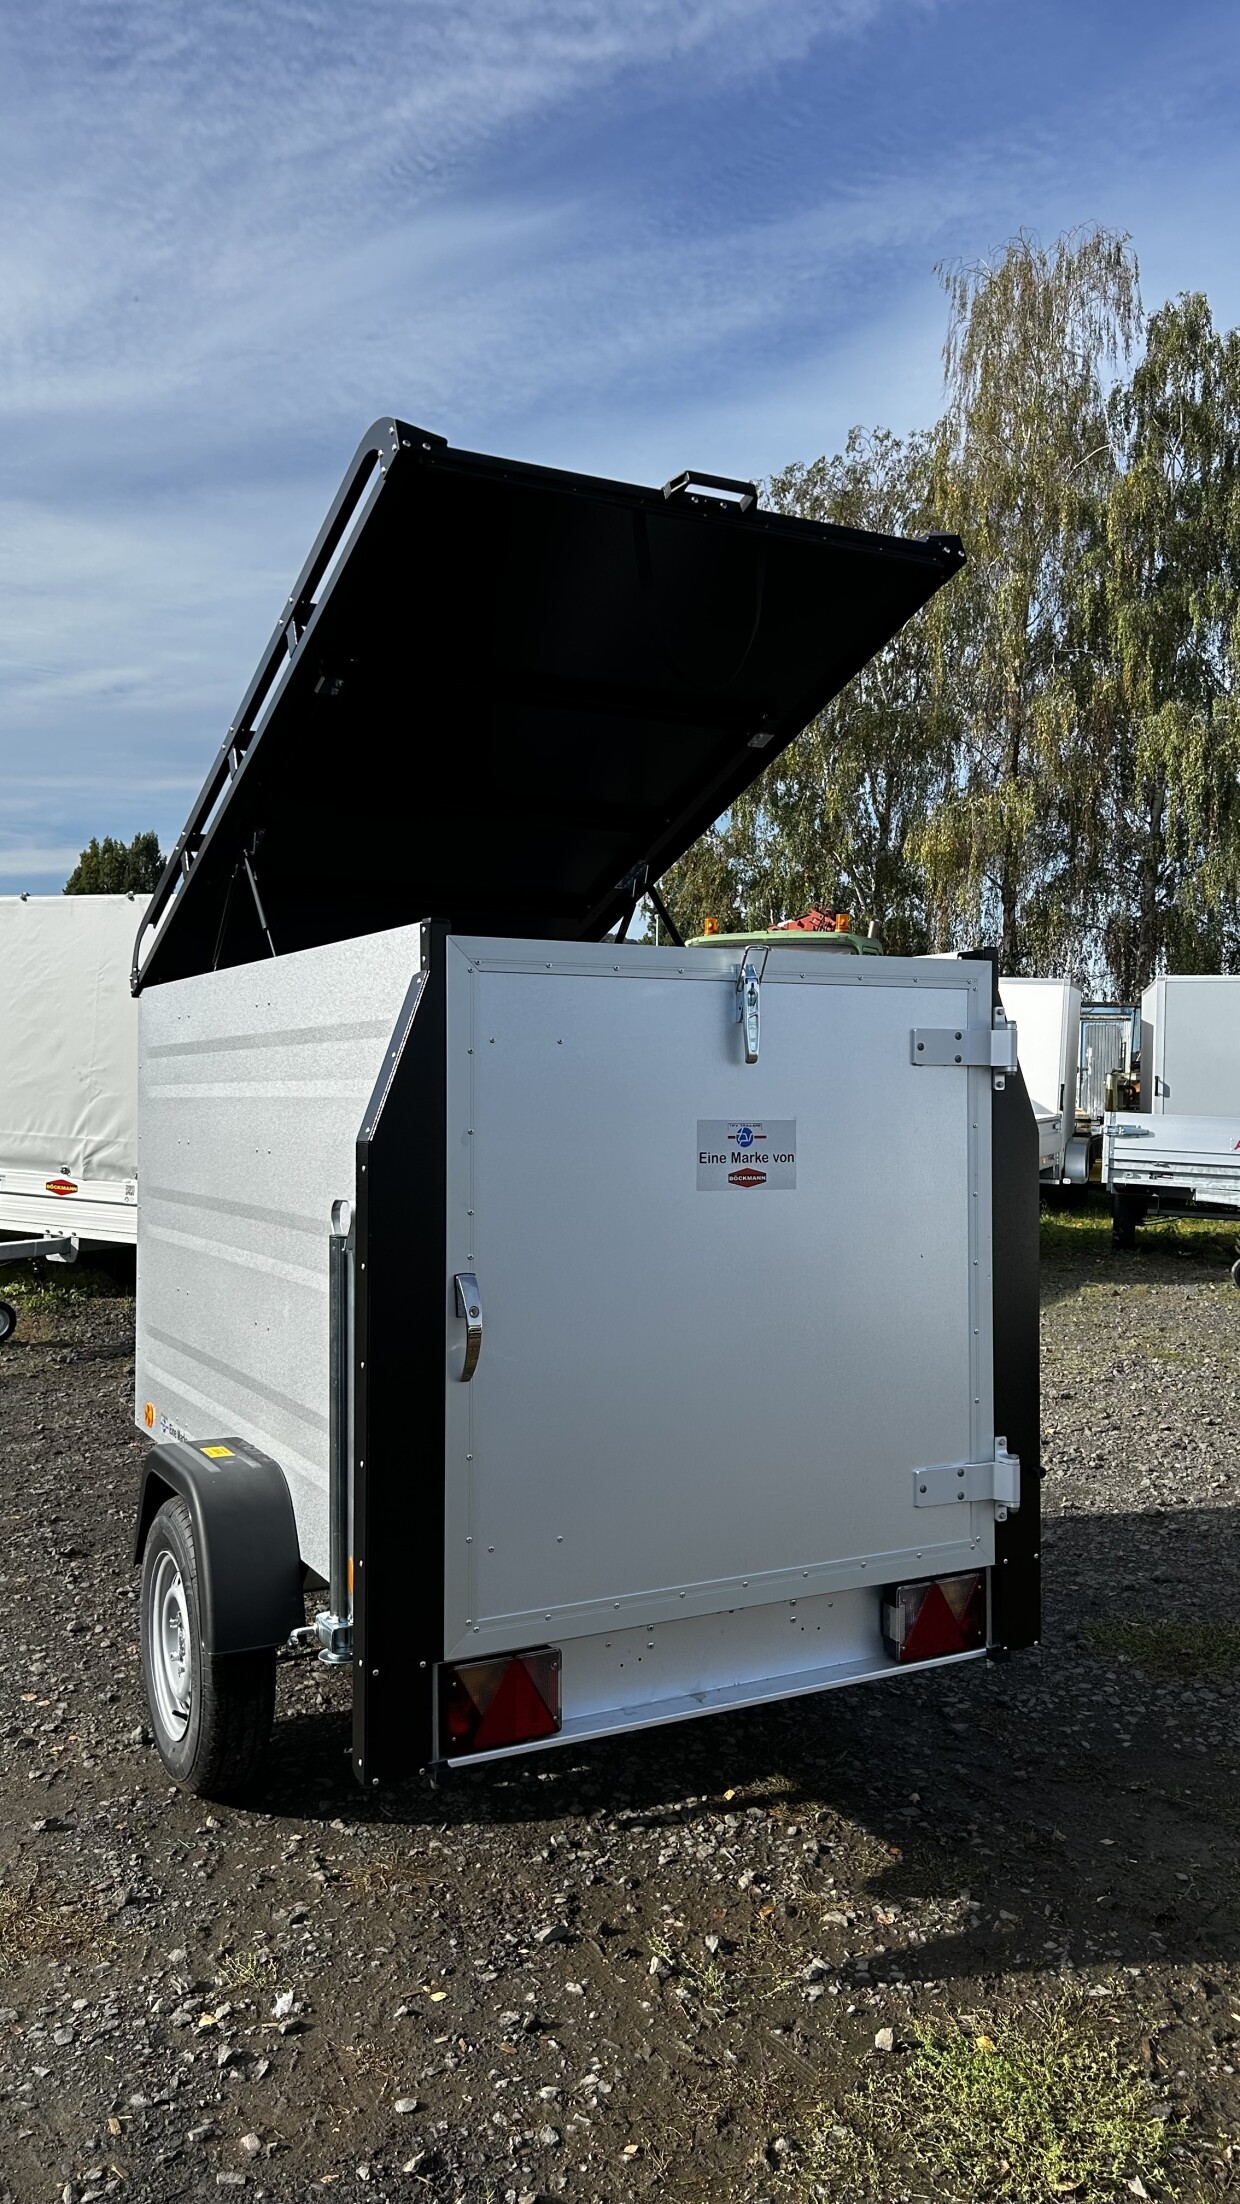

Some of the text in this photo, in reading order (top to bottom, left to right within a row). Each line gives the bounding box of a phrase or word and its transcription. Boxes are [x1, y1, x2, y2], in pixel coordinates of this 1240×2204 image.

[699, 1151, 795, 1164] Eine Marke von
[46, 1183, 78, 1192] BÖCKMANN
